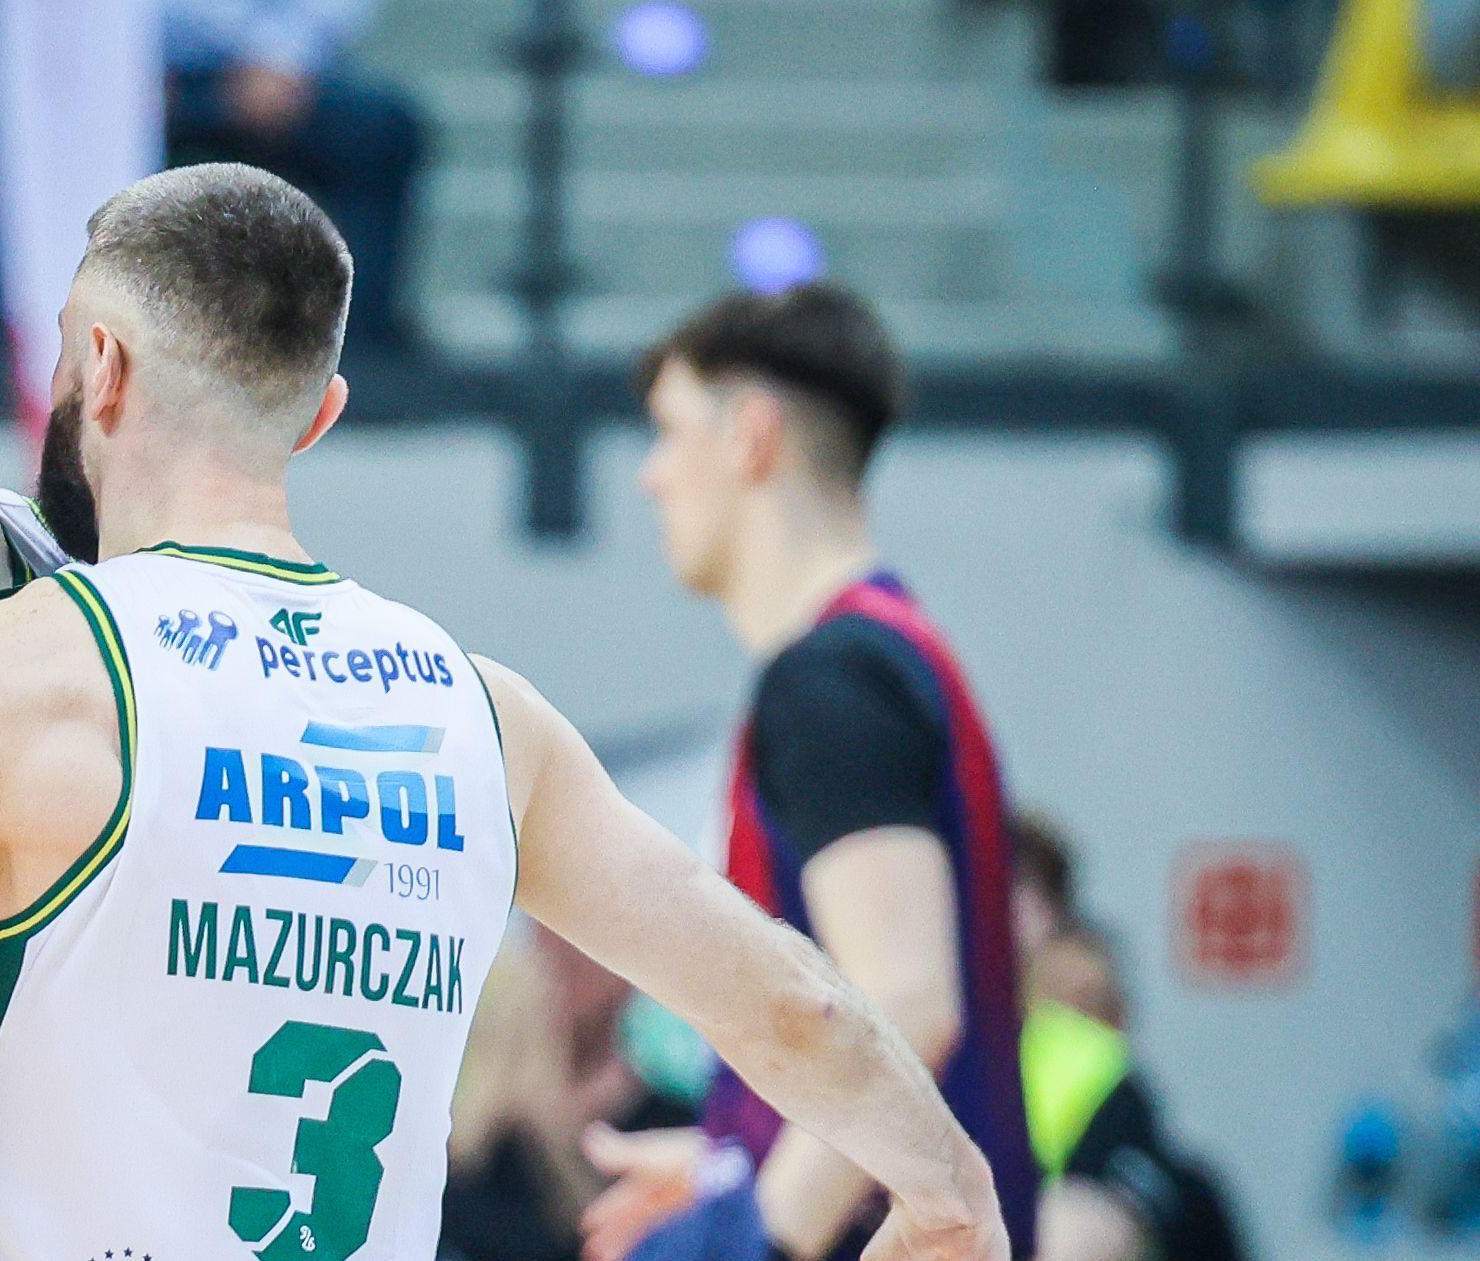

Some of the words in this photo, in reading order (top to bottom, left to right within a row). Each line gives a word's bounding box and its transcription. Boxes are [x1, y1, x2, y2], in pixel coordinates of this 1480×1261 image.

[255, 636, 454, 693] perceptus
[194, 746, 465, 852] ARPOL
[384, 862, 440, 900] 1991
[166, 898, 466, 1014] MAZURCZAK
[228, 1019, 403, 1261] 3
